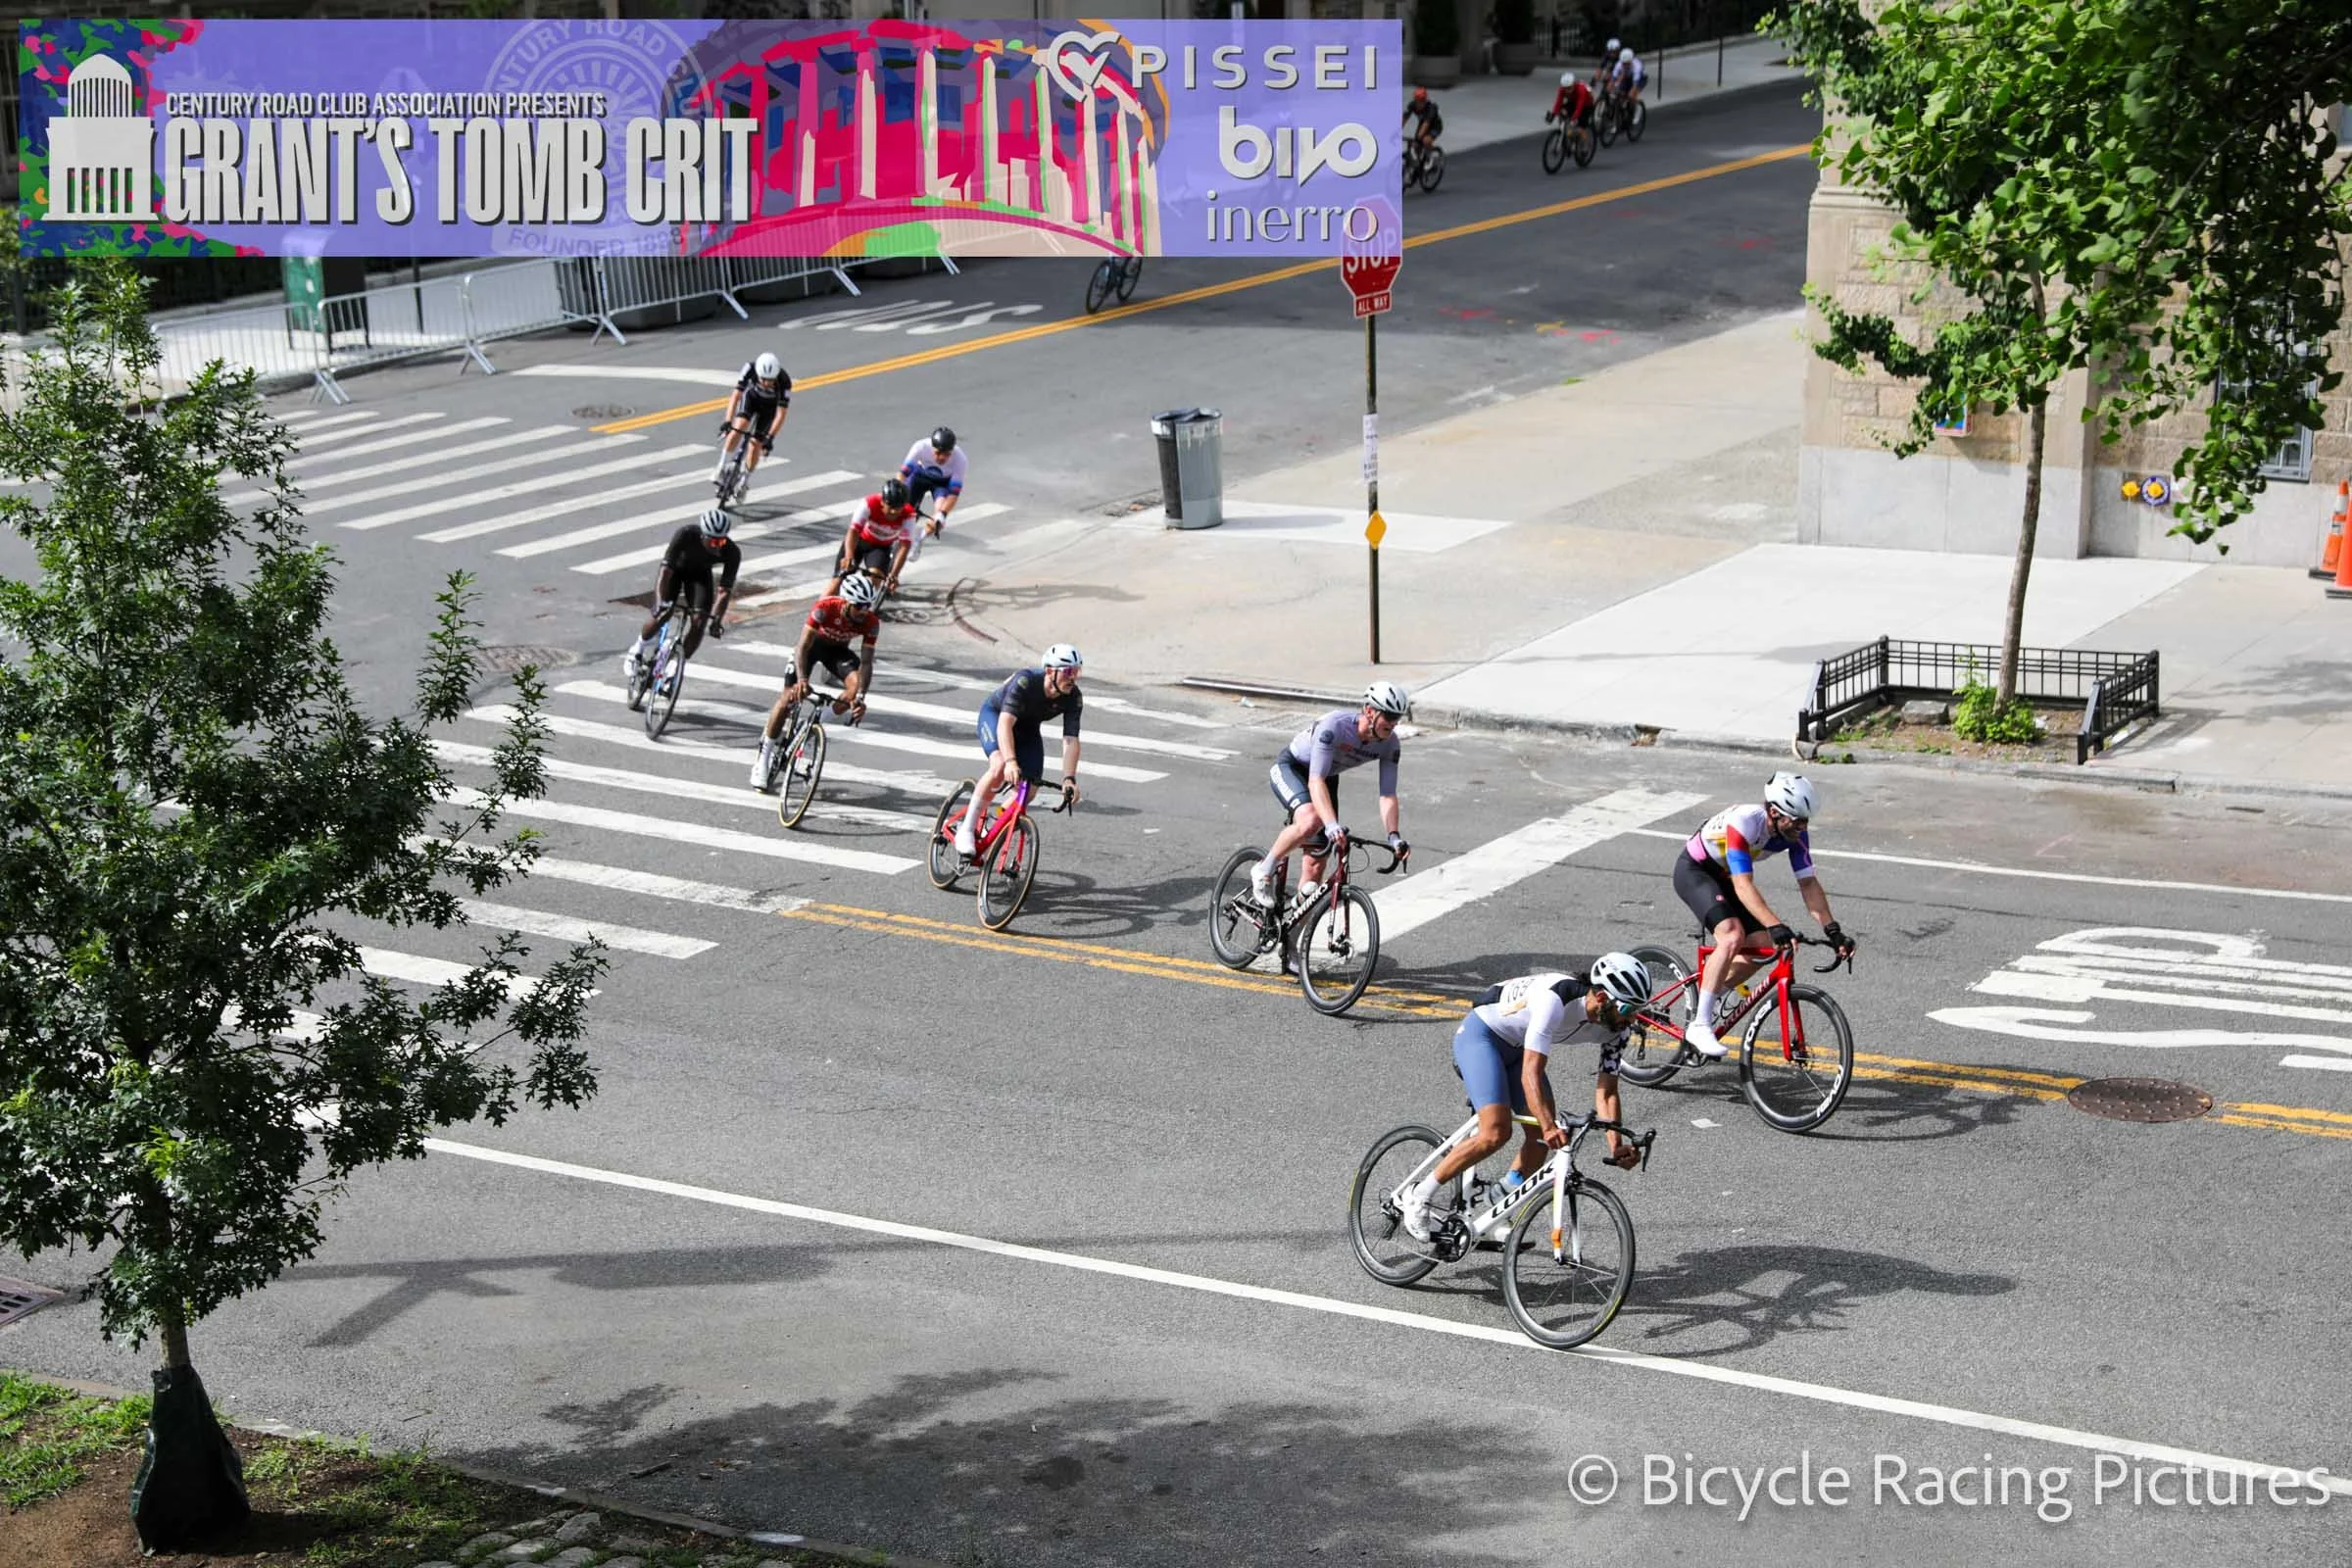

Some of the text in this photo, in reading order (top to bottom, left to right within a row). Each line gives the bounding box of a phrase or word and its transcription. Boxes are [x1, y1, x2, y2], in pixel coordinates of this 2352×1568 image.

[1346, 227, 1398, 273] STOP
[1357, 294, 1389, 314] ALL WAY
[1492, 1161, 1555, 1219] LOOK
